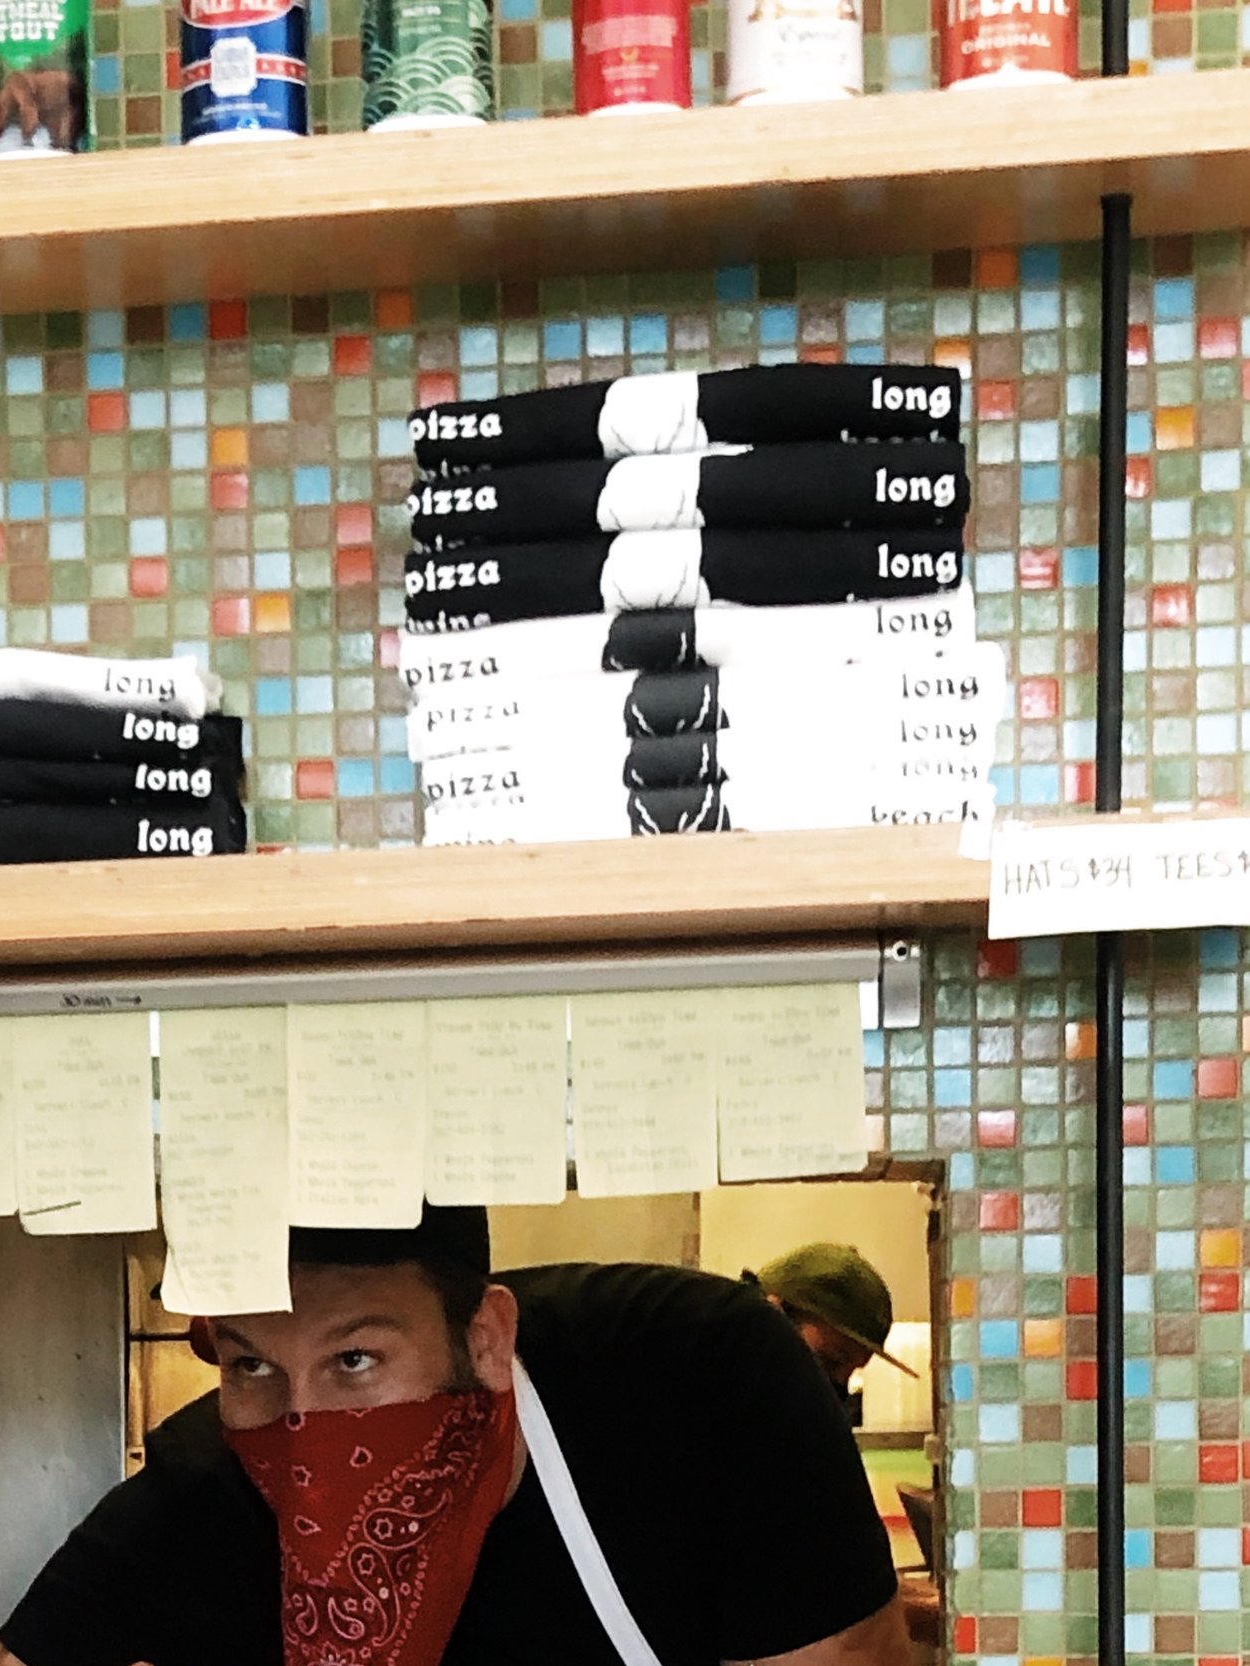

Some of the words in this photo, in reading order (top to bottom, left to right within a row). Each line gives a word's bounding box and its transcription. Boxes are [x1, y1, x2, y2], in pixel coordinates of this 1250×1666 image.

[871, 376, 952, 419] long
[875, 467, 956, 508] long
[877, 542, 958, 584] long
[876, 605, 953, 638] long
[105, 667, 177, 702] long
[405, 656, 499, 688] pizza
[902, 673, 979, 700] long
[123, 712, 200, 750] long
[427, 701, 520, 732] pizza
[901, 719, 978, 746] long
[135, 763, 212, 798] long
[137, 818, 214, 857] long
[1004, 857, 1081, 896] HATS
[1155, 850, 1233, 881] TEES
